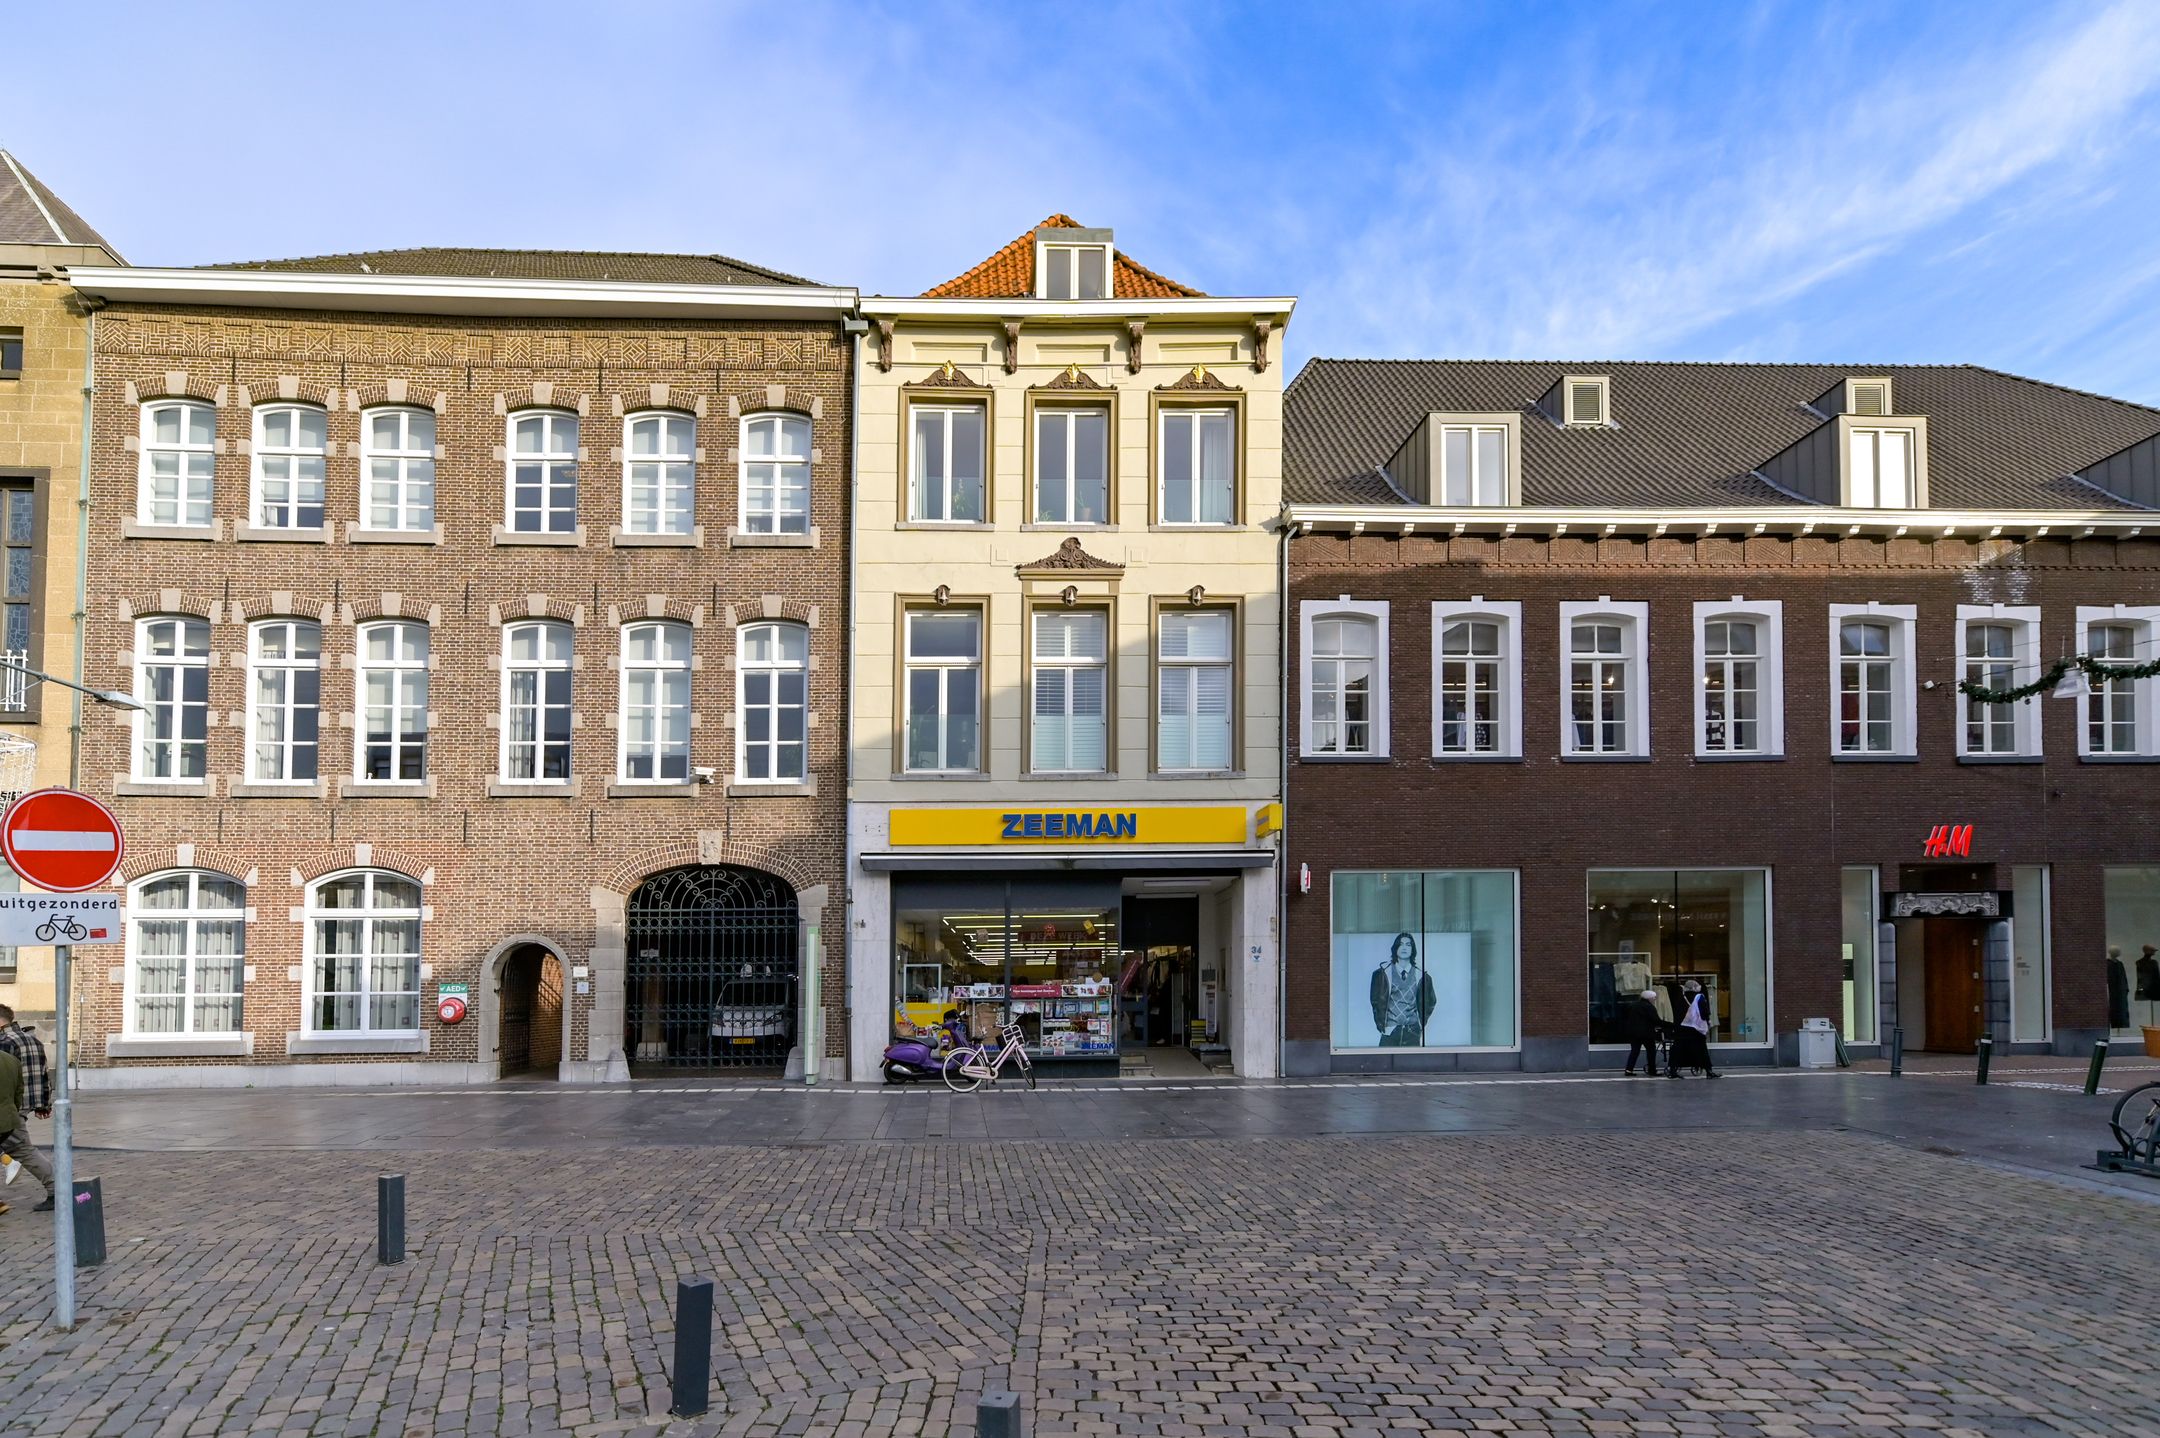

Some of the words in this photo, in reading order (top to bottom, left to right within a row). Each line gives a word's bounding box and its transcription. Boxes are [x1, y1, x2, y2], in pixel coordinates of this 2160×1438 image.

[1002, 813, 1137, 837] ZEEMAN
[1923, 824, 1973, 857] H&M
[0, 897, 117, 912] uitgezonderd
[1251, 945, 1262, 954] 34
